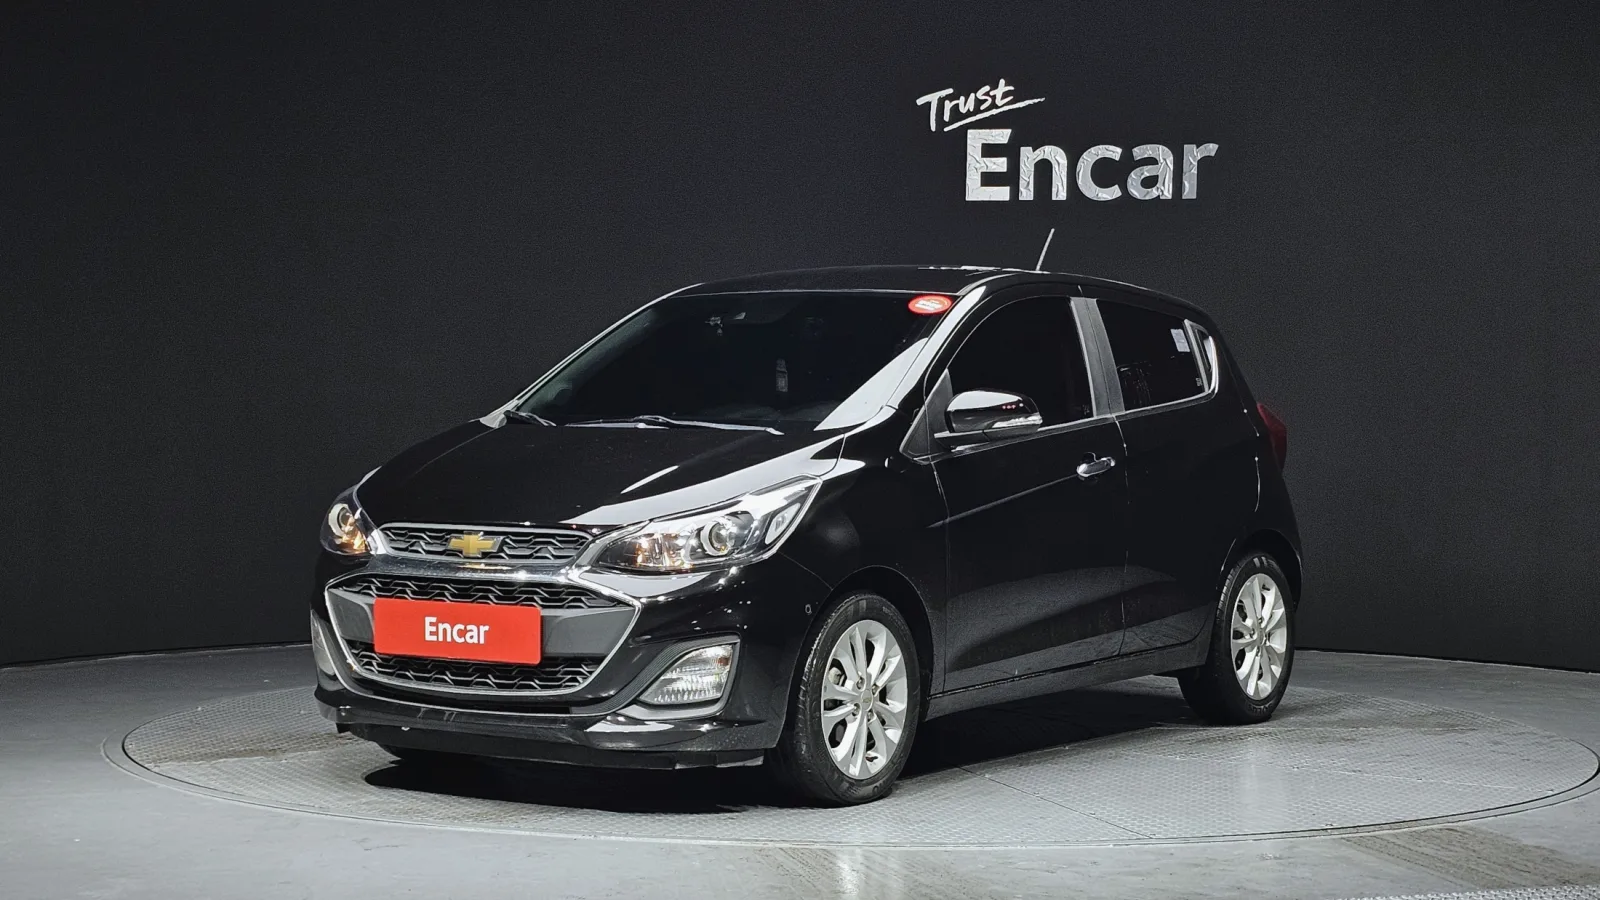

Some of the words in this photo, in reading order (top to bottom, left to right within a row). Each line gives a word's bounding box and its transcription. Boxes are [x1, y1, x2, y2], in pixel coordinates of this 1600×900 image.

[916, 79, 1014, 131] Trust
[965, 129, 1219, 201] Encar
[424, 616, 489, 644] Encar
